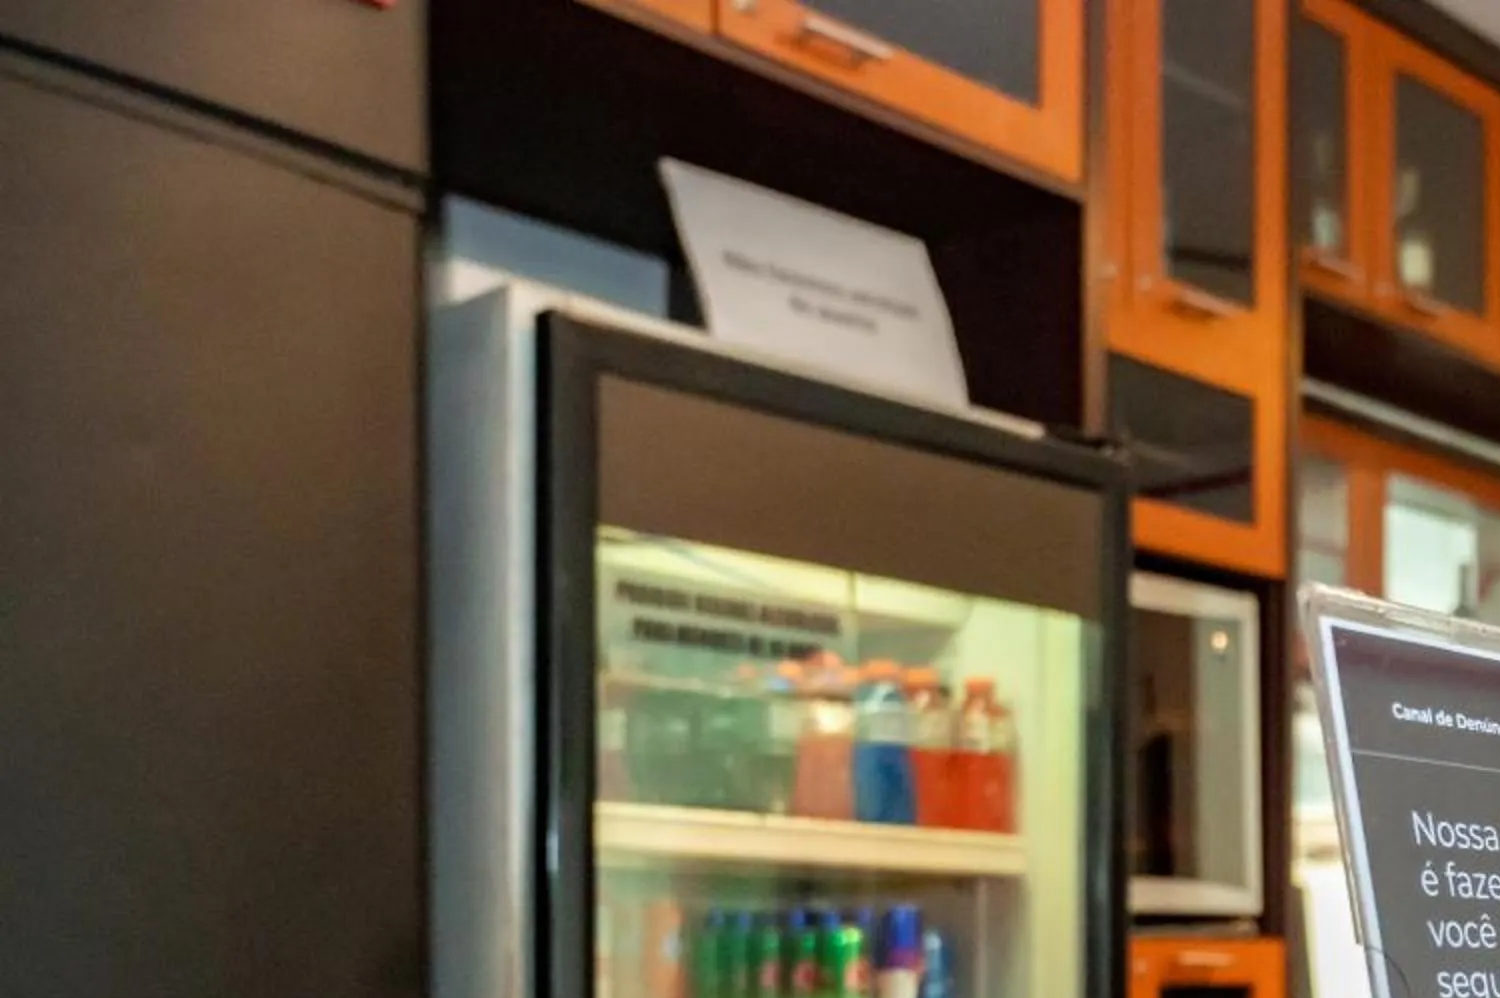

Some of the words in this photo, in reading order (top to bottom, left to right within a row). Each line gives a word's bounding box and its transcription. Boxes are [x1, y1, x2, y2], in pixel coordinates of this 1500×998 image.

[1391, 701, 1433, 724] Canal
[1435, 709, 1454, 728] de
[1410, 810, 1499, 851] Nossa
[1420, 861, 1440, 896] é
[1426, 914, 1497, 949] você
